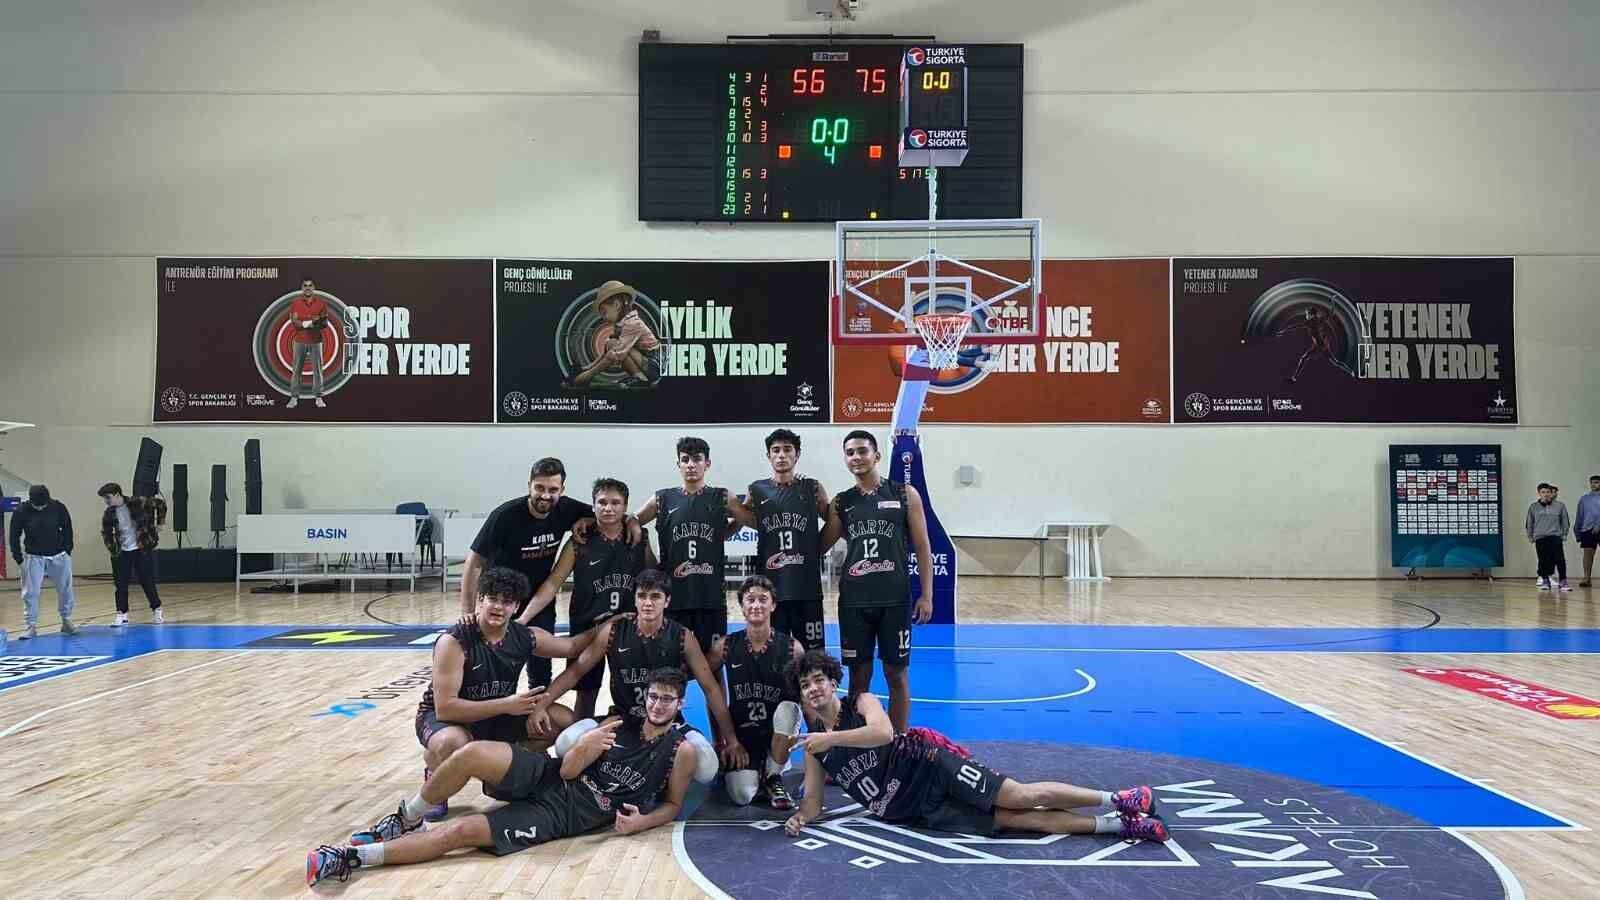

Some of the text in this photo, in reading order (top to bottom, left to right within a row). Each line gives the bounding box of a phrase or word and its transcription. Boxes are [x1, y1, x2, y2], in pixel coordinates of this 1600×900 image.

[729, 72, 736, 82] 4
[744, 72, 752, 83] 3
[792, 69, 886, 93] 56 75
[728, 84, 767, 95] 6 2
[729, 96, 767, 107] 7 15 4
[728, 108, 752, 119] 8 2
[729, 120, 767, 131] 9 7 3
[726, 132, 767, 143] 10 10 3
[726, 144, 736, 155] 11
[823, 145, 836, 164] 4
[726, 156, 736, 167] 12
[726, 168, 767, 179] 13 15 3
[899, 168, 906, 179] 5
[726, 180, 736, 191] 15
[726, 192, 736, 203] 16
[744, 192, 752, 203] 2
[722, 204, 736, 215] 23
[744, 204, 752, 215] 2
[165, 265, 279, 279] ANTRENÖR EĞİTİM PROGRAMI
[503, 266, 573, 281] GENÇ GÖNÜLLÜLER
[1184, 268, 1258, 280] YETENEK TARAMASI
[503, 280, 535, 293] PROJESİ
[1183, 280, 1215, 293] PROJESİ
[343, 306, 410, 339] SPOR
[660, 299, 733, 339] İYİLİK
[1356, 302, 1472, 339] YETENEK
[343, 343, 470, 376] HER YERDE
[659, 343, 788, 377] HER YERDE
[990, 341, 1120, 373] HER YERDE
[1358, 343, 1500, 380] HER YERDE
[761, 511, 808, 532] KARYA
[847, 519, 895, 540] KARYA
[306, 527, 348, 540] BASIN
[532, 532, 556, 545] KARYA
[672, 521, 715, 542] KARYA
[778, 530, 793, 550] 13
[688, 540, 697, 559] 6
[863, 538, 879, 559] 12
[609, 591, 620, 610] 9
[805, 621, 823, 641] 99
[898, 630, 910, 649] 12
[733, 682, 782, 701] KARYA
[747, 701, 767, 722] 23
[599, 760, 647, 792] KARYA
[835, 750, 881, 789] KARYA
[956, 764, 982, 789] 10
[857, 776, 880, 801] 10
[514, 825, 537, 839] 7
[1263, 797, 1410, 870] HOTELS
